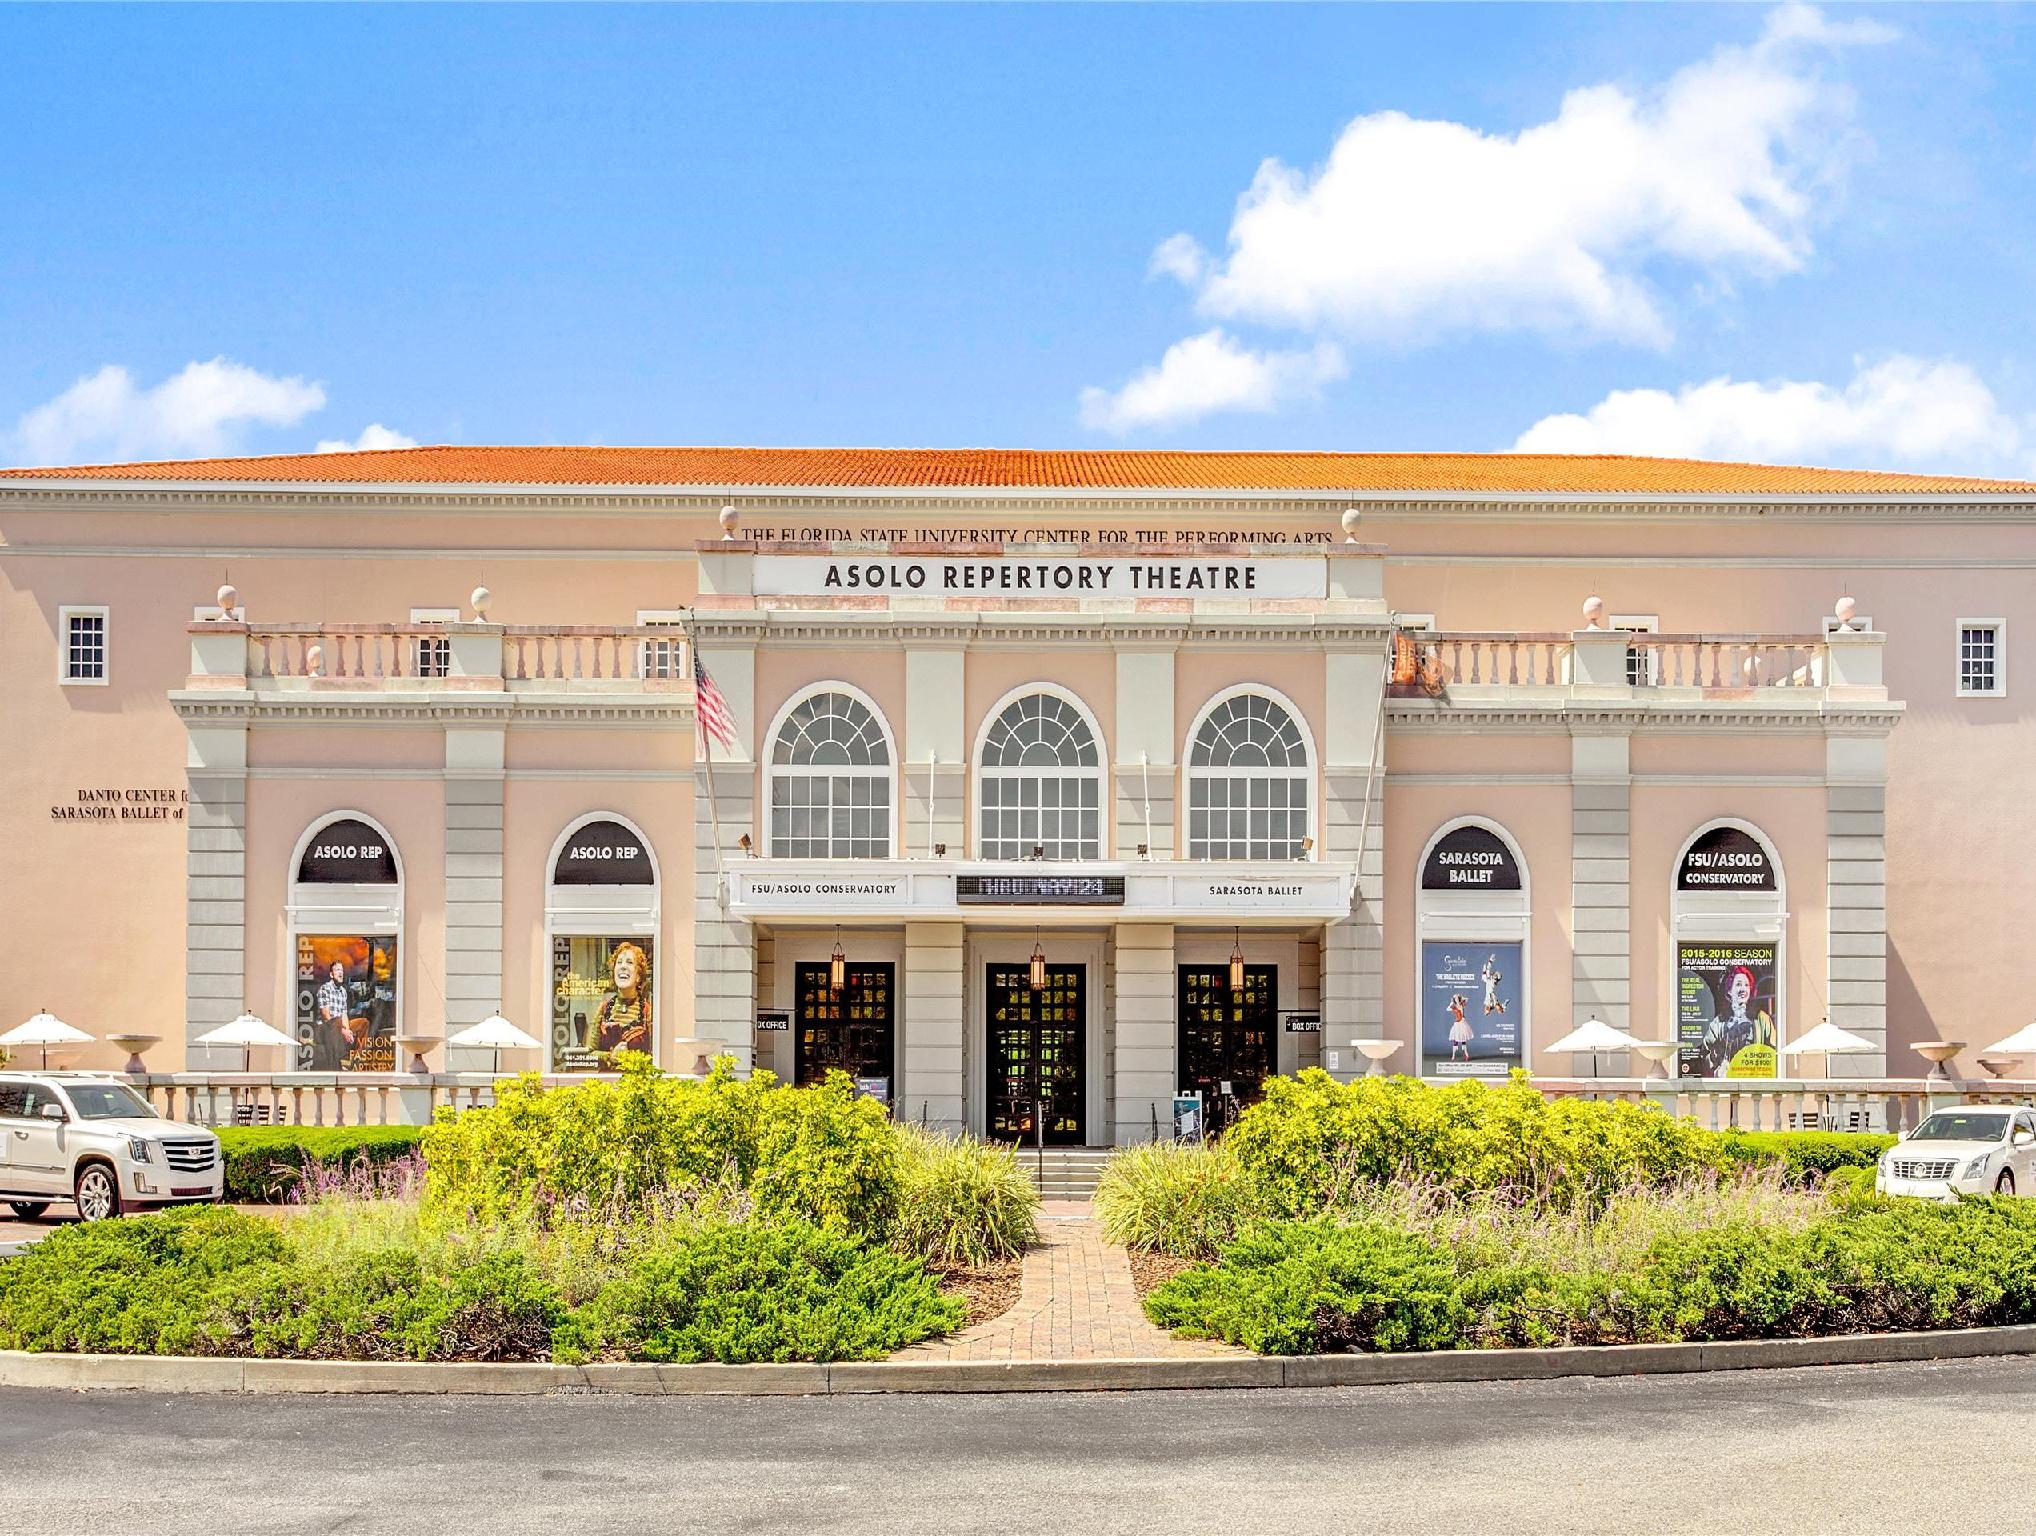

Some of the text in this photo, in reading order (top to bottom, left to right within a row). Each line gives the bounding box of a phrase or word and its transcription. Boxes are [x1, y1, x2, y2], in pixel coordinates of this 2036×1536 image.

[742, 528, 1332, 543] THE FLORIDA STATE UNIVERSITY CENTER FOR THE PERFORMING ARTS
[825, 565, 1256, 589] ASOLO REPERTORY THEATRE
[78, 789, 121, 801] DANTO
[125, 789, 175, 801] CENTER
[51, 806, 184, 819] SARASOTA BALLET of
[314, 845, 383, 859] ASOLO REP
[570, 846, 639, 859] ASOLO REP
[1439, 852, 1503, 865] SARASOTA
[1688, 853, 1763, 867] FSU/ASOLO
[1449, 869, 1493, 883] BALLET
[1685, 873, 1765, 884] CONSERVATORY
[752, 884, 896, 894] FSU/ASOLO CONSERVATORY
[1209, 886, 1303, 895] SARASOTA BALLET
[298, 937, 315, 980] REP
[554, 938, 570, 981] REP
[1681, 949, 1772, 958] 2015-2016 SEASON
[567, 972, 580, 980] the
[562, 977, 610, 989] American
[556, 986, 606, 996] character
[766, 1020, 787, 1030] OFFICE
[1292, 1022, 1304, 1031] BOX
